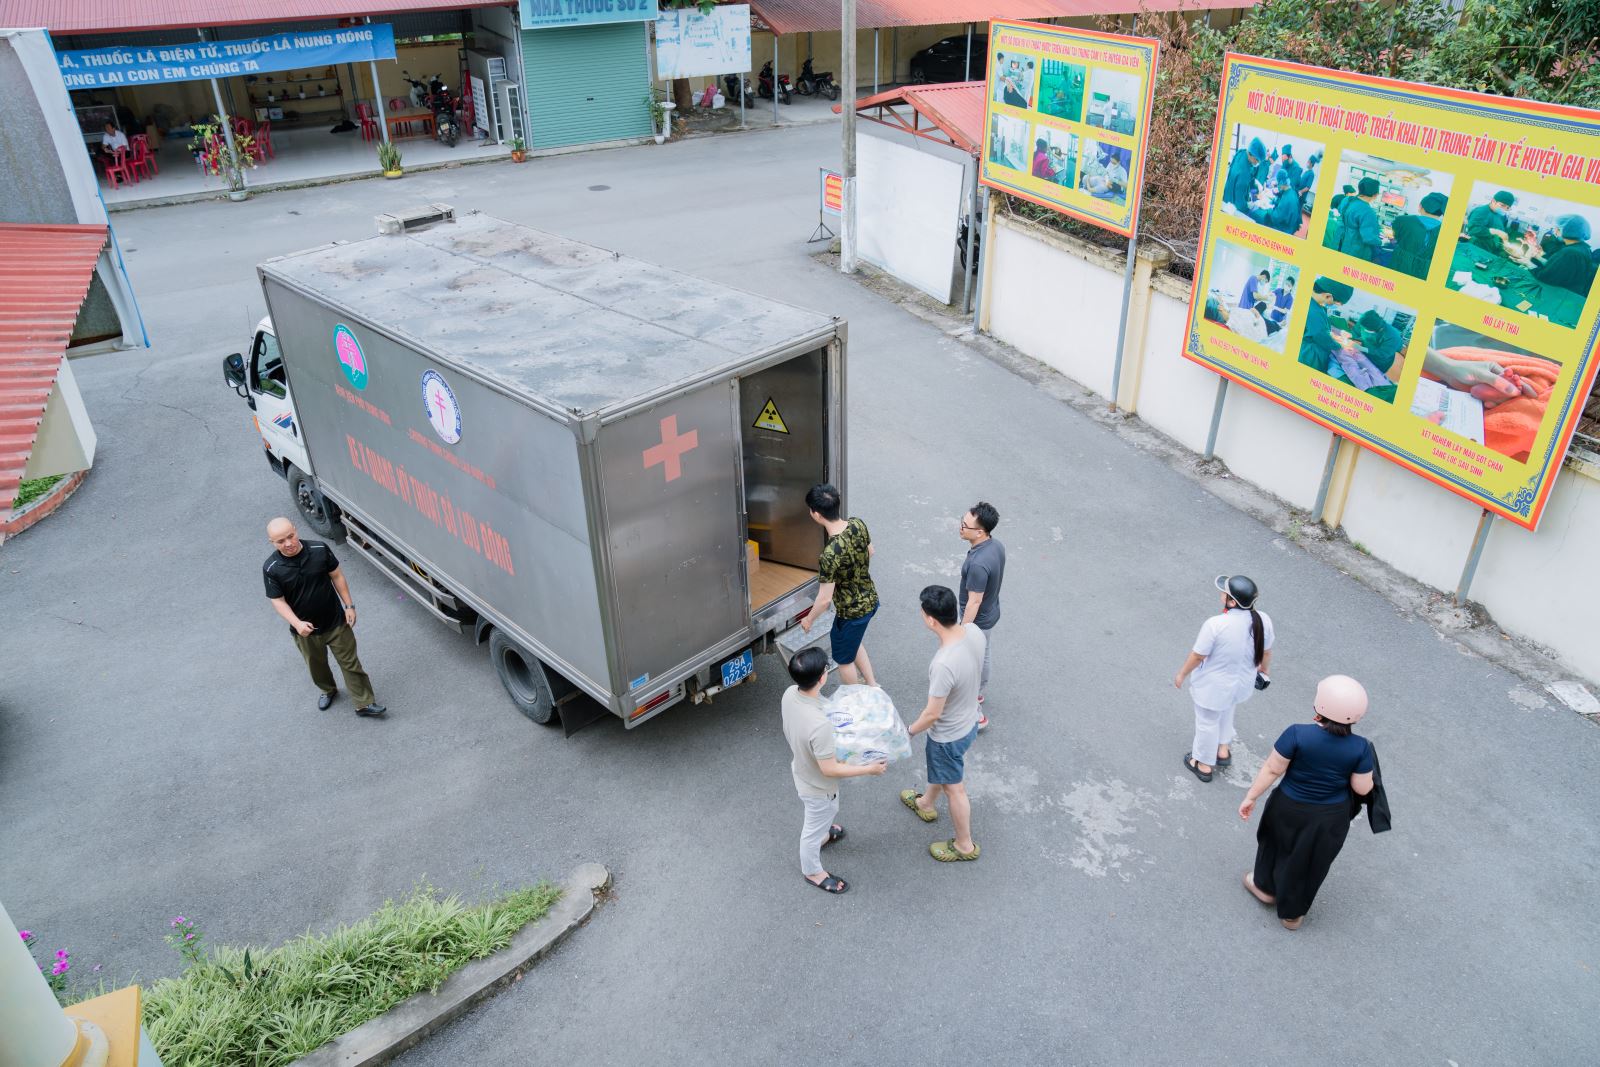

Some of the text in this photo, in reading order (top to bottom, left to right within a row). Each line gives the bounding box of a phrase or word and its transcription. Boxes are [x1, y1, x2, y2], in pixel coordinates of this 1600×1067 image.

[81, 49, 134, 68] THUỐC
[160, 47, 196, 62] ĐIỆN
[224, 40, 271, 57] THUỐC
[295, 34, 333, 49] NUNG
[98, 70, 124, 84] LAI
[127, 68, 160, 82] CON
[163, 66, 186, 79] EM
[190, 59, 239, 76] CHÚNG
[242, 60, 260, 72] TA
[1247, 87, 1264, 114] MỘT
[1264, 87, 1278, 114] SỐ
[1275, 96, 1294, 120] DỊCH
[1294, 101, 1307, 125] VỤ
[1306, 98, 1319, 123] KỸ
[1318, 103, 1346, 133] THUẬT
[1344, 111, 1369, 138] ĐƯỢC
[1369, 111, 1397, 141] TRIỂN
[1397, 121, 1421, 147] KHAI
[1420, 126, 1438, 154] TẠI
[1437, 129, 1472, 157] TRUNG
[1471, 132, 1498, 163] TÂM
[1496, 141, 1508, 165] Y
[1506, 136, 1527, 169] TẾ
[1520, 144, 1564, 180] HUYỆN
[1561, 153, 1585, 181] GIA
[729, 655, 746, 673] 29A
